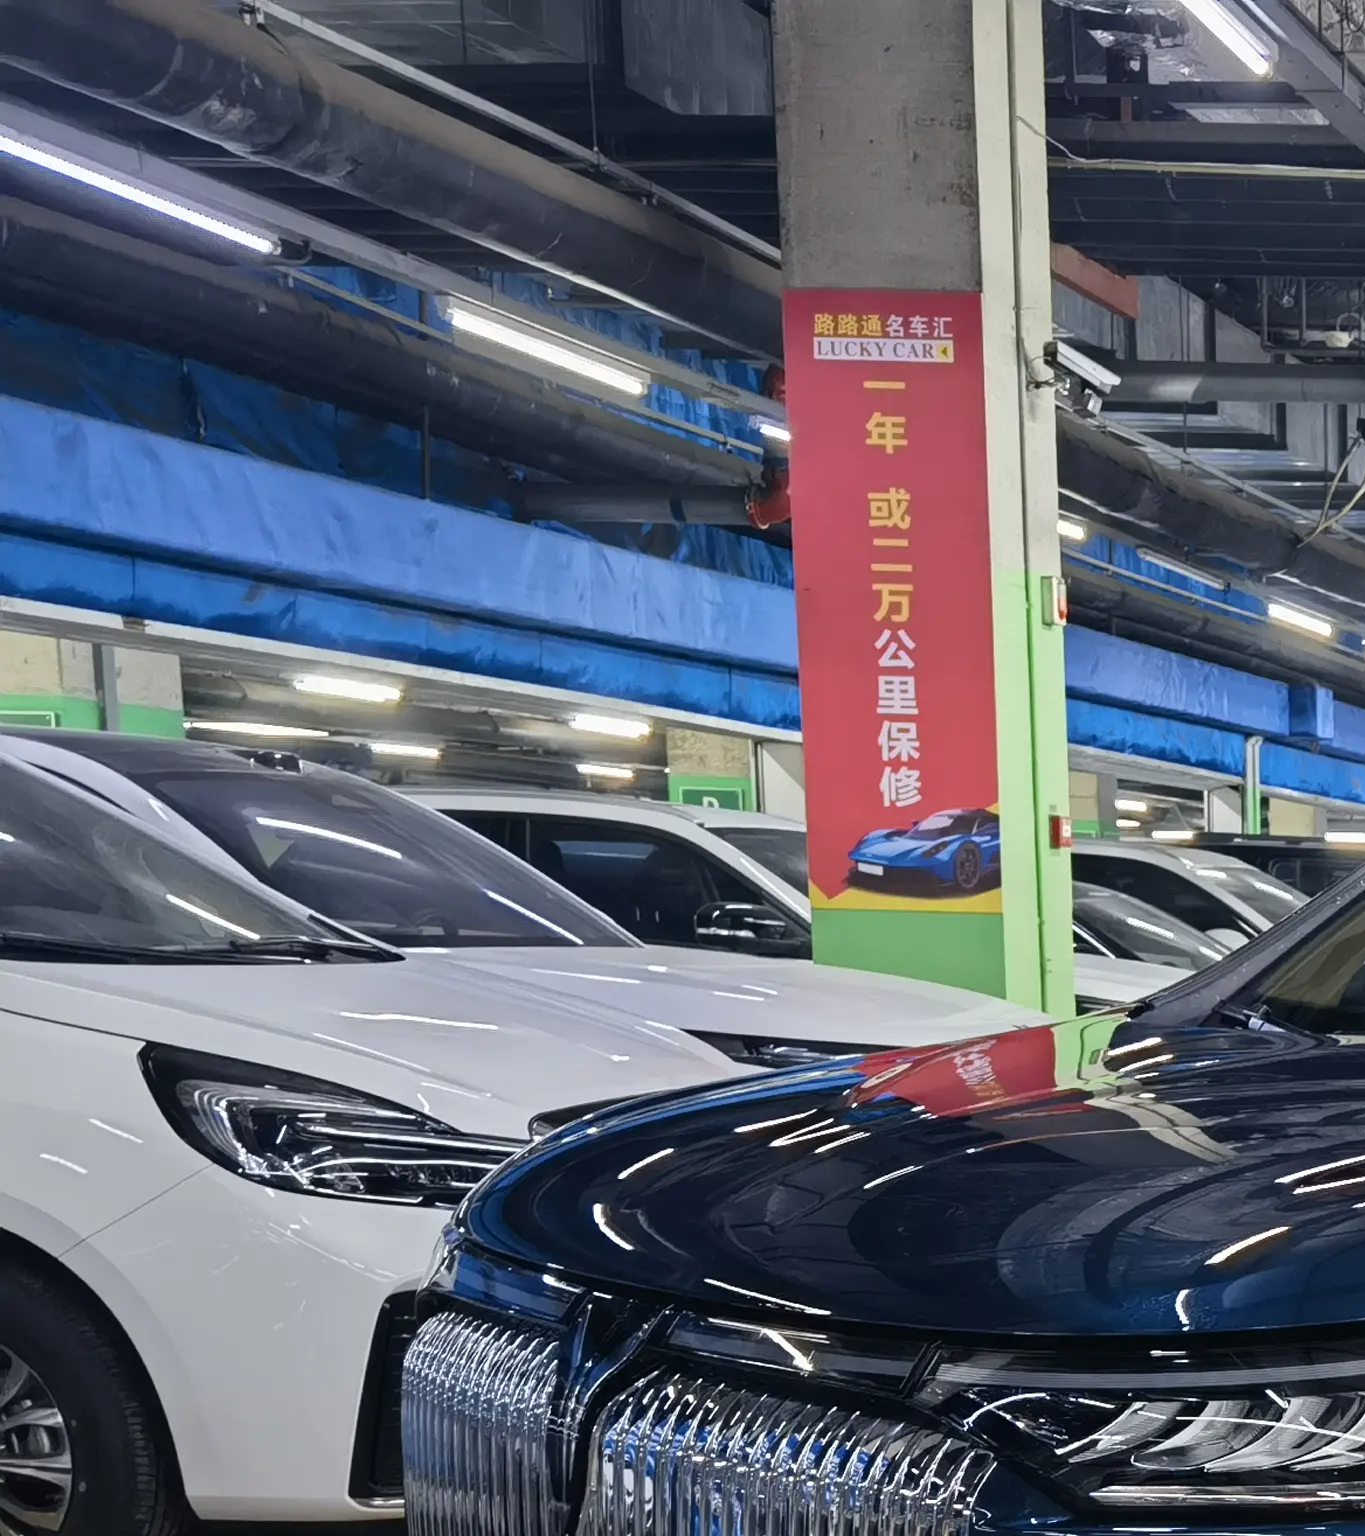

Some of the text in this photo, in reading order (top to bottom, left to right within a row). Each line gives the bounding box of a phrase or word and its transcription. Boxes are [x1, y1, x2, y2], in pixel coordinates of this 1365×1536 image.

[813, 313, 953, 337] 路路通名车汇
[816, 340, 935, 359] LUCKY CAR
